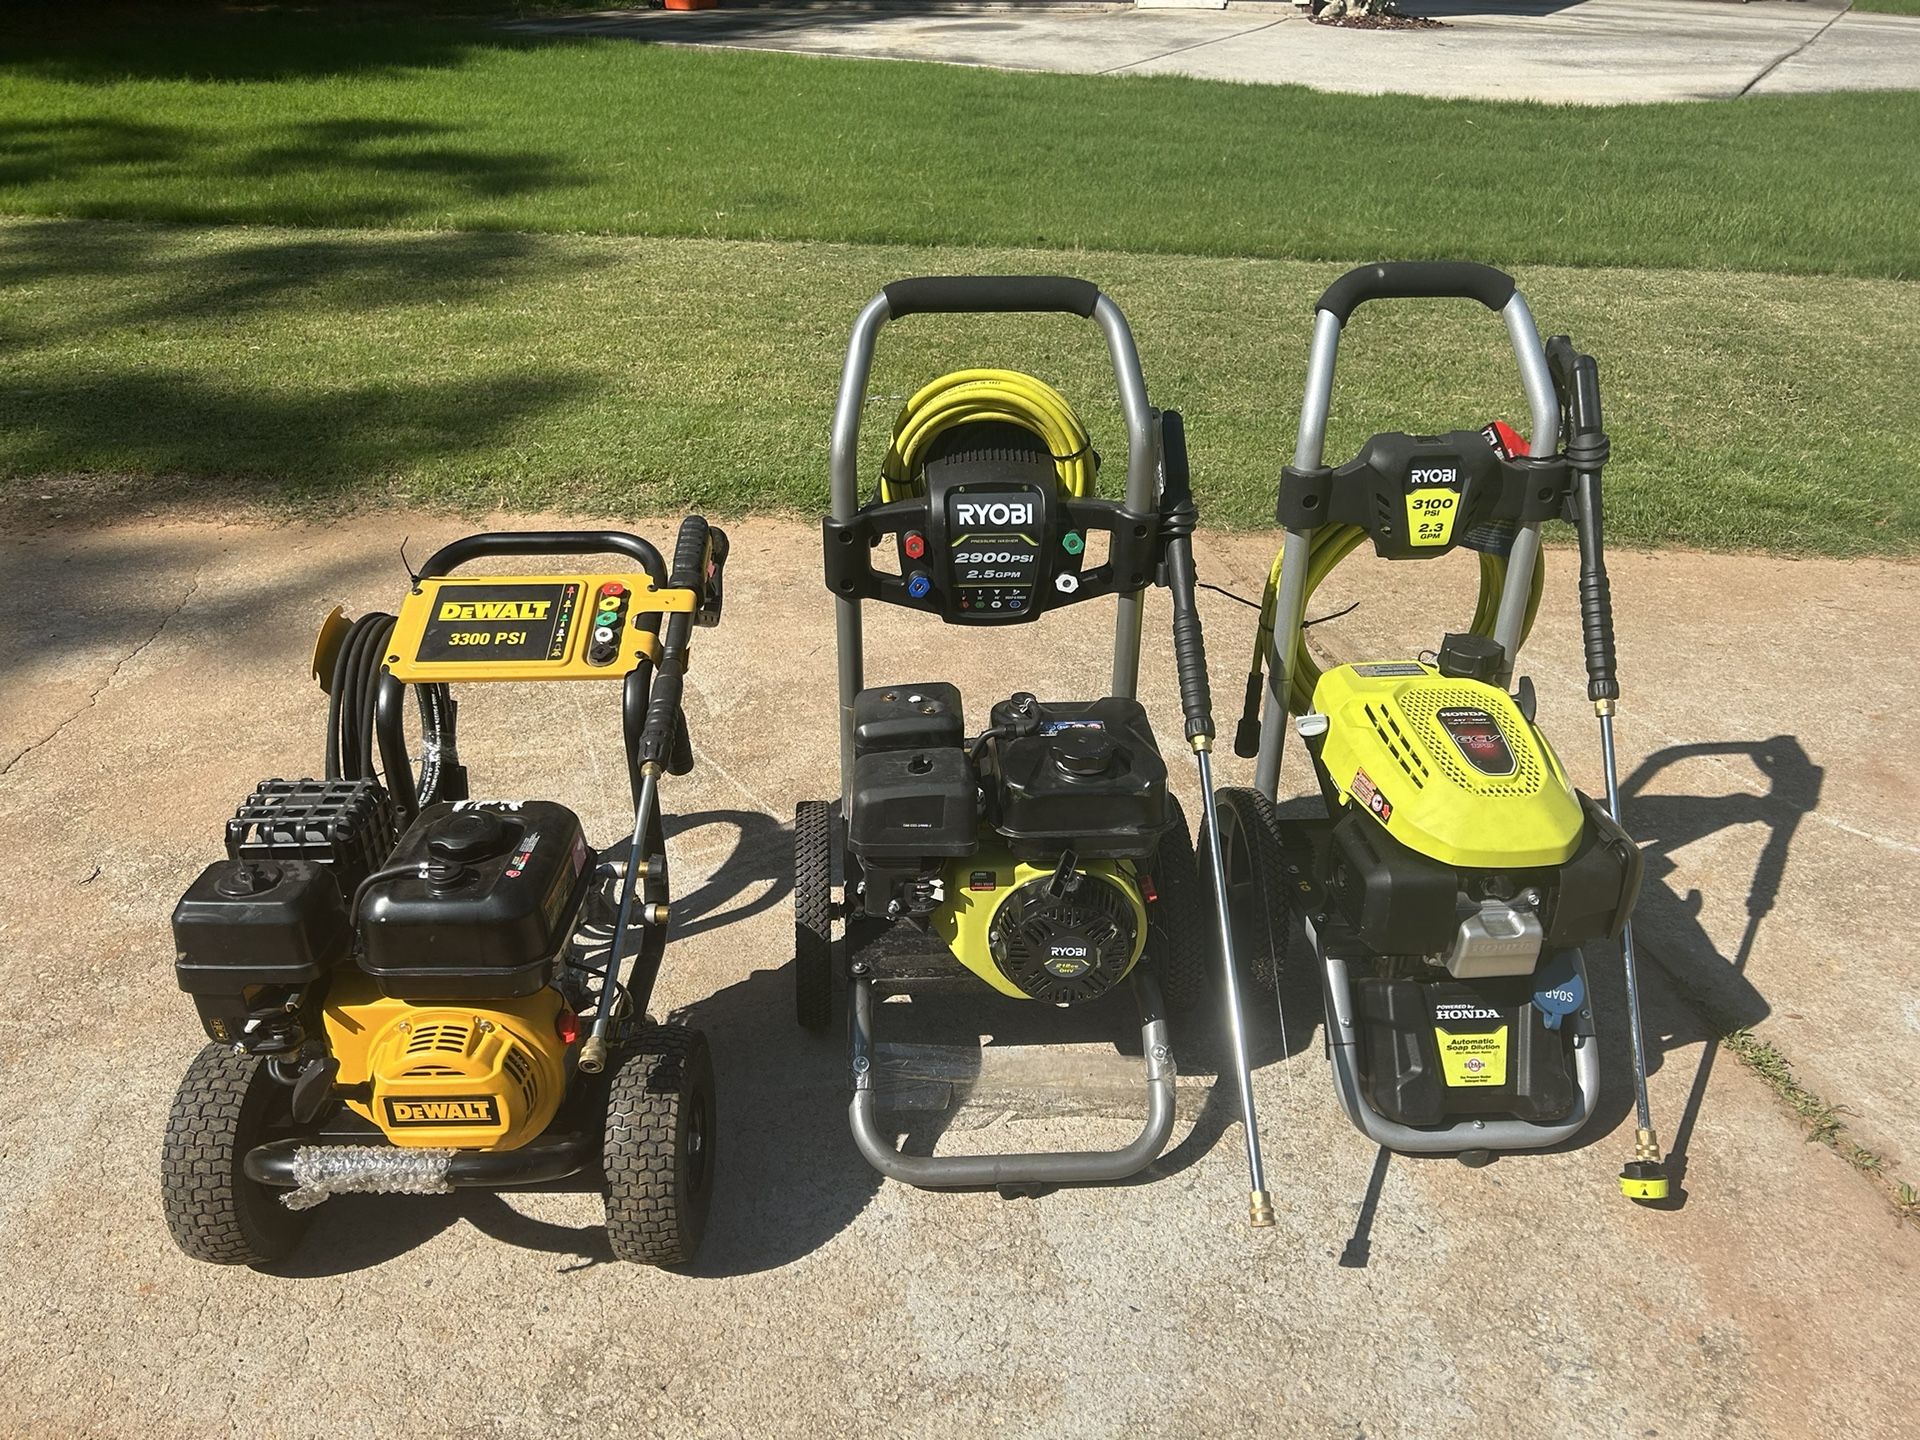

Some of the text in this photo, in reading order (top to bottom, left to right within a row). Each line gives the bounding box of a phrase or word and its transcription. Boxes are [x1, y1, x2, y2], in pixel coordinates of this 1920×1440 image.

[1411, 468, 1457, 484] RYOBI
[1412, 498, 1453, 510] 3100
[956, 503, 1033, 525] RYOBI
[1418, 522, 1444, 533] 2.3
[438, 601, 551, 621] DEWALT
[448, 631, 527, 646] 3300 PSI
[1051, 947, 1086, 956] RYOBI
[1545, 989, 1574, 1003] SOAP
[1436, 1009, 1500, 1020] HONDA
[392, 1102, 491, 1120] DEWALT
